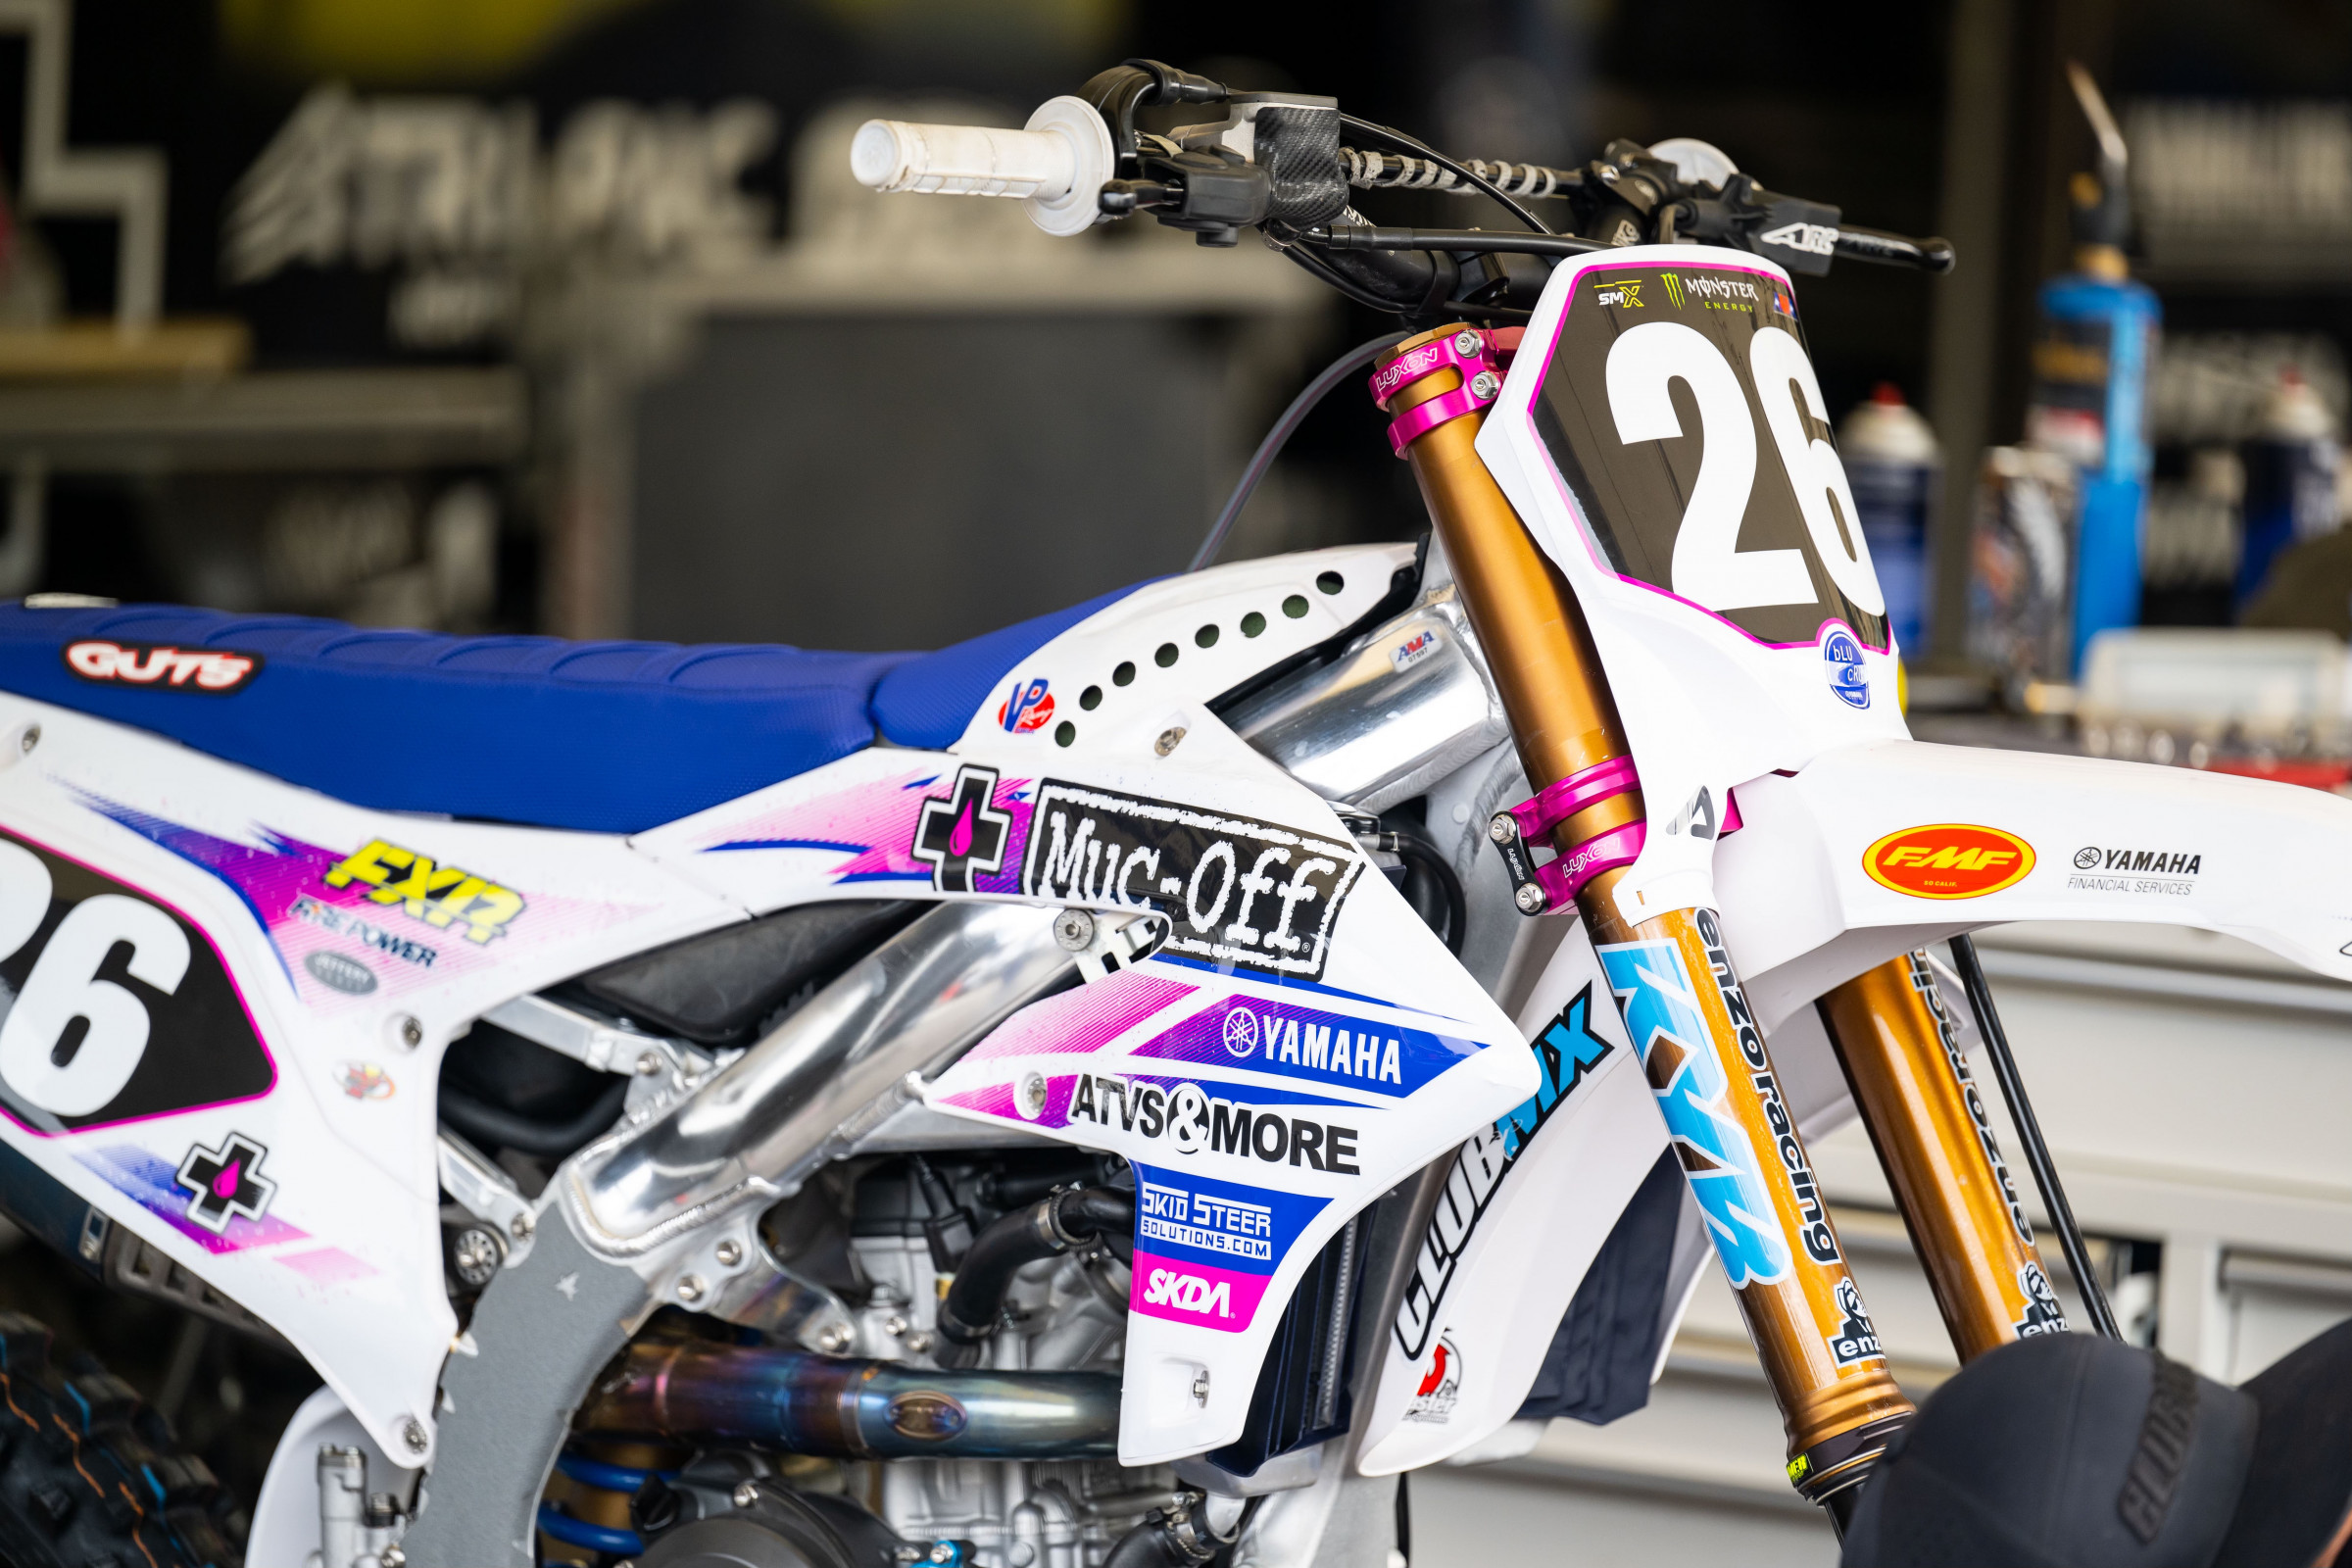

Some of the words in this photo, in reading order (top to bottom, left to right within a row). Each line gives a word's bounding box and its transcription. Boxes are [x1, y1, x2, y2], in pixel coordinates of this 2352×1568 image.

[1598, 285, 1644, 309] SMX
[1685, 275, 1760, 302] MONSTER
[1704, 301, 1754, 313] ENERGY
[1376, 347, 1438, 392] LUXON
[1605, 321, 1886, 616] 26
[67, 640, 253, 690] GUTS
[1397, 630, 1435, 662] AMA
[1004, 678, 1049, 733] VP
[1562, 837, 1621, 878] LUXON
[1882, 846, 2018, 871] FMF
[2105, 849, 2201, 874] YAMAHA
[323, 838, 526, 946] FXR
[1040, 811, 1337, 953] Muc-Off
[2068, 877, 2131, 892] FINANCIAL
[2134, 881, 2192, 896] SERVICES
[347, 919, 438, 967] POWER
[1263, 1014, 1401, 1085] YAMAHA
[1071, 1073, 1360, 1175] ATVS&MORE
[1596, 940, 1791, 1288] KYB
[1142, 1181, 1189, 1221] SKID
[1193, 1193, 1271, 1237] STEER
[1142, 1218, 1268, 1257] SOLUTIONS.COM
[1143, 1268, 1231, 1318] SKDA
[1838, 1336, 1882, 1357] enz
